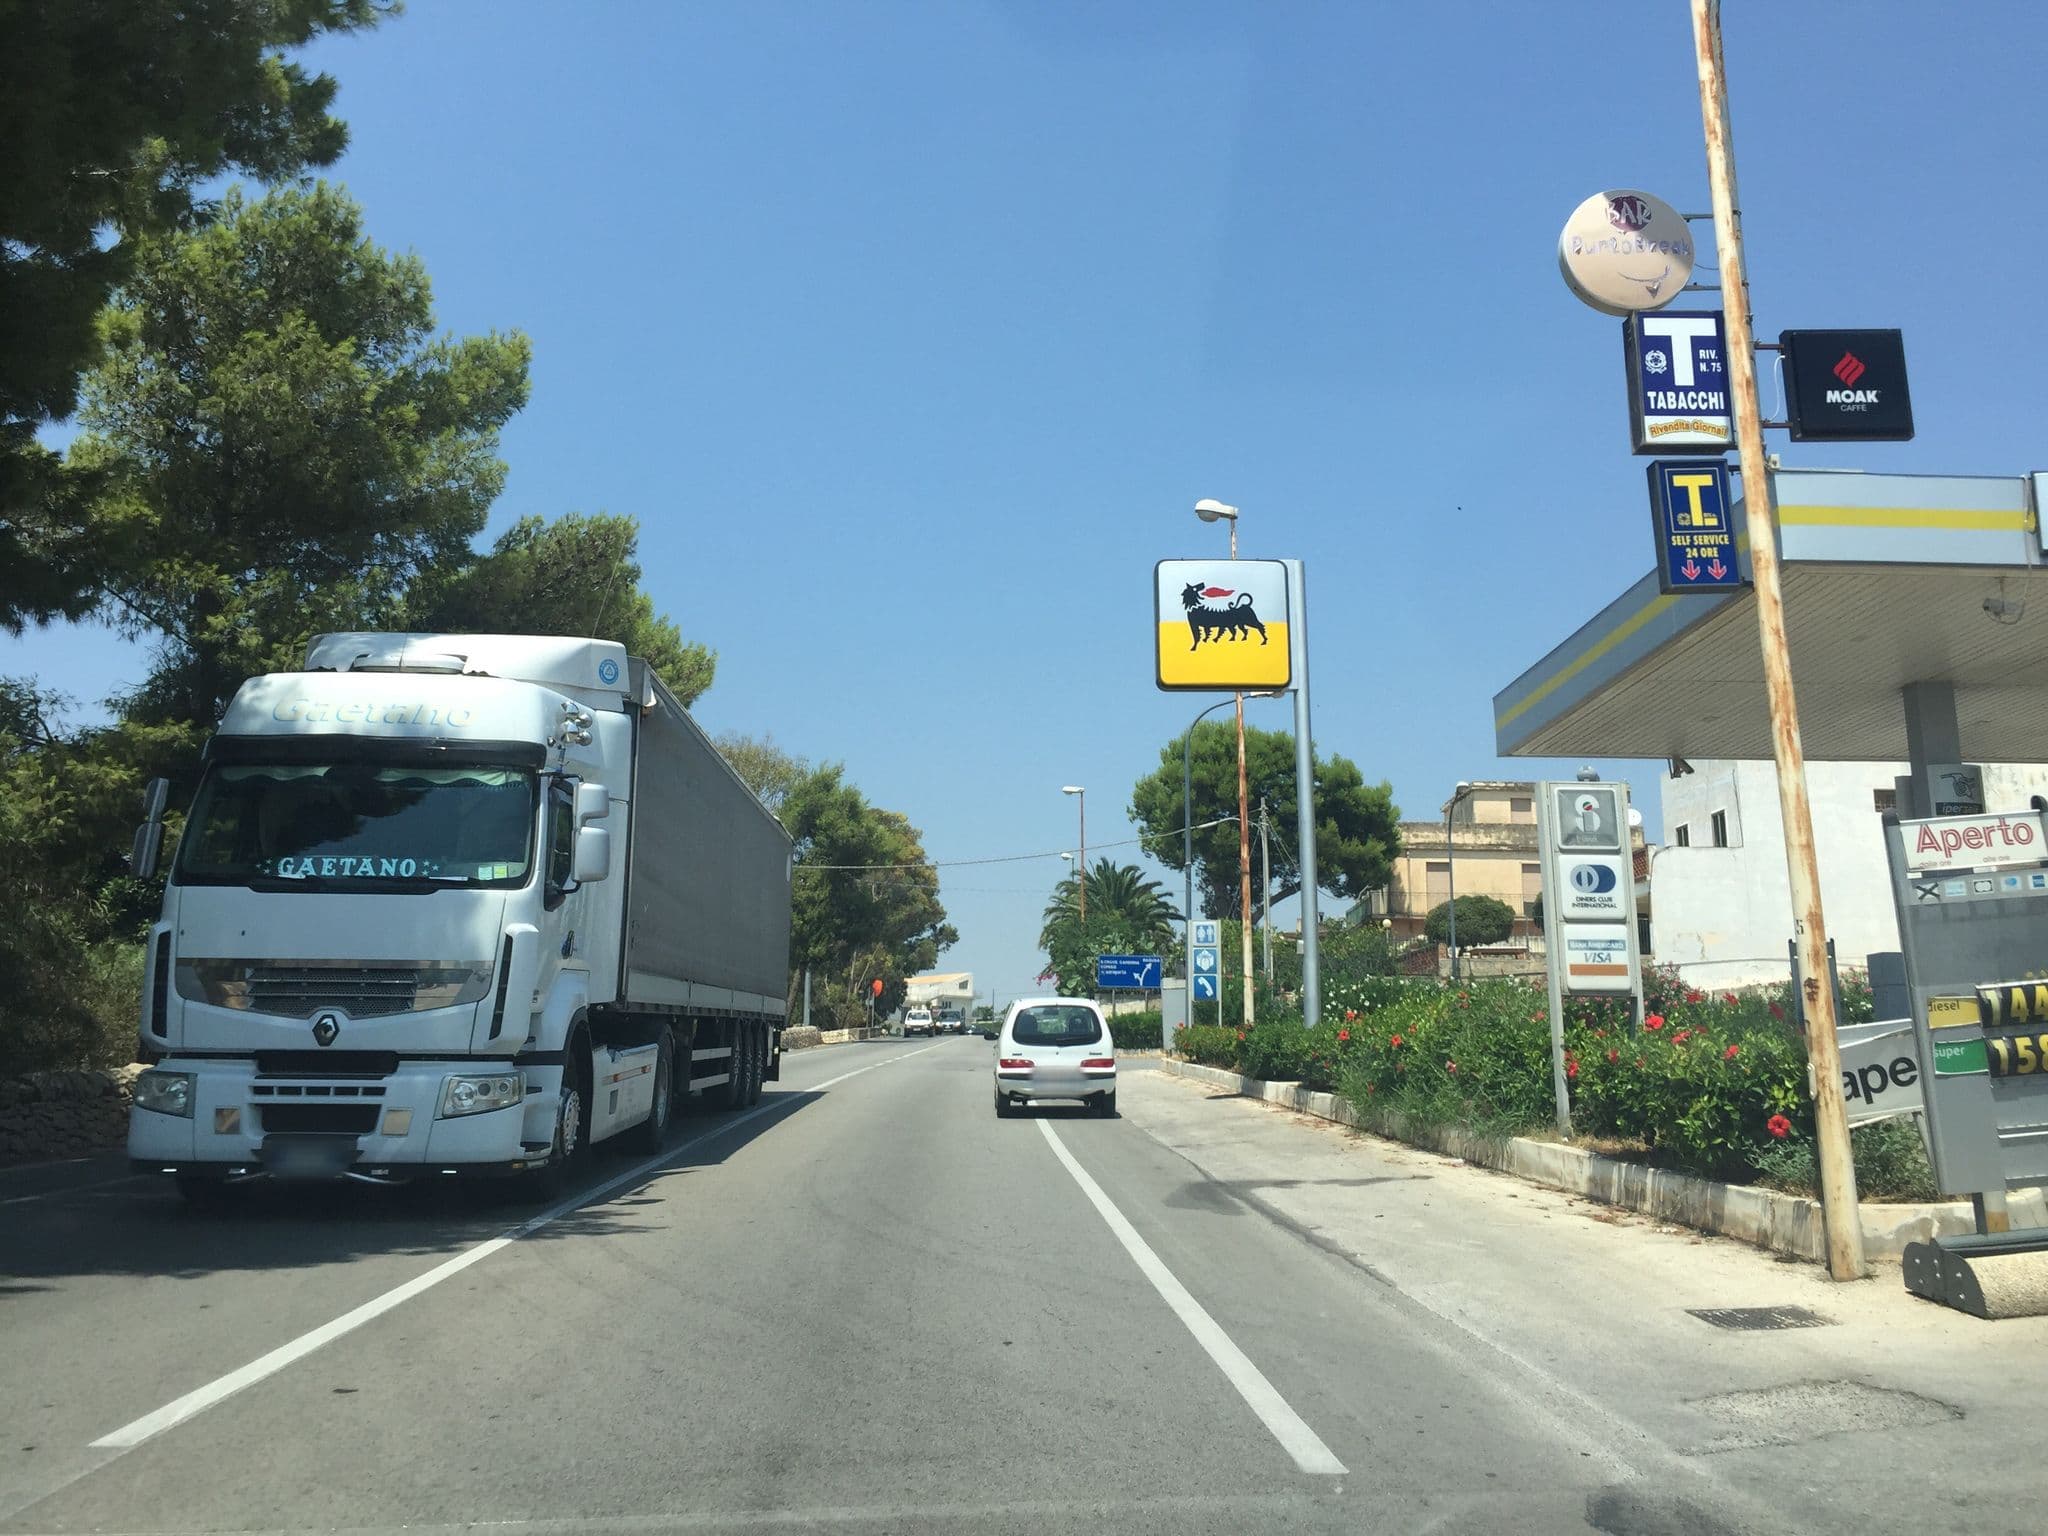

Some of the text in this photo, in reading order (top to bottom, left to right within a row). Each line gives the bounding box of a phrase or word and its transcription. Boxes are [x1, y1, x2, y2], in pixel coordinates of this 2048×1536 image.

[1607, 199, 1652, 225] BAR
[1643, 317, 1717, 386] T
[1699, 349, 1718, 360] RIV.
[1699, 362, 1722, 373] N. 75
[1647, 391, 1725, 410] TABACCHI
[1826, 390, 1879, 403] MOAK
[1649, 420, 1690, 437] Rivendita
[1671, 534, 1729, 546] SELF SERVICE
[1686, 547, 1719, 558] 24 ORE
[272, 698, 474, 728] Gaetano
[1917, 816, 2034, 858] Aperto
[278, 857, 417, 877] GAETANO
[1584, 952, 1612, 963] VISA
[1928, 1000, 1960, 1012] diesel
[1933, 1046, 1965, 1062] super
